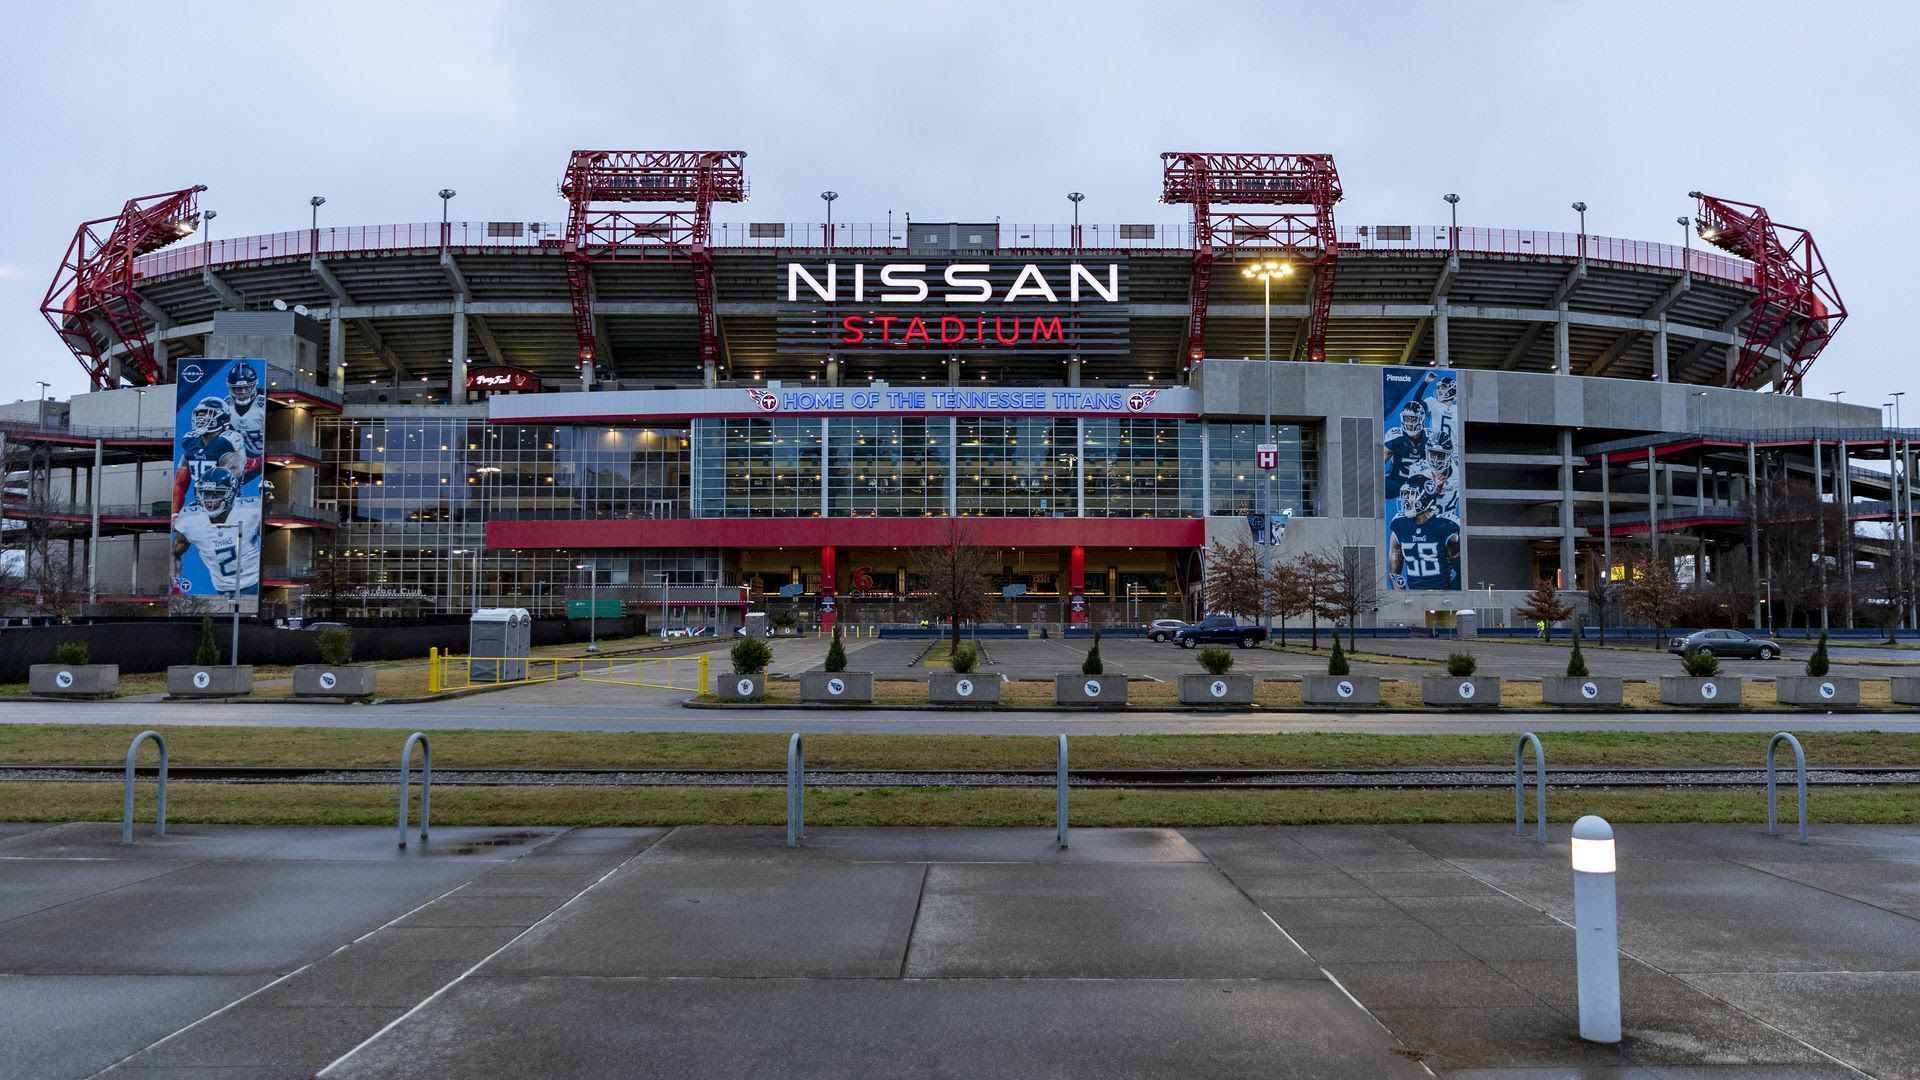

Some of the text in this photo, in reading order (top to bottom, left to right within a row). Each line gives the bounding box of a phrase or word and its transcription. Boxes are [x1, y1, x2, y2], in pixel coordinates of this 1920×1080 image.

[788, 263, 1119, 302] NISSAN
[842, 316, 1065, 343] STADIUM
[1386, 374, 1412, 382] Pinnacle
[783, 391, 1122, 410] HOME OF THE TENNESSEE TITANS
[1260, 452, 1274, 467] H
[215, 546, 242, 577] 2
[1401, 542, 1441, 577] 58
[853, 566, 873, 591] 6
